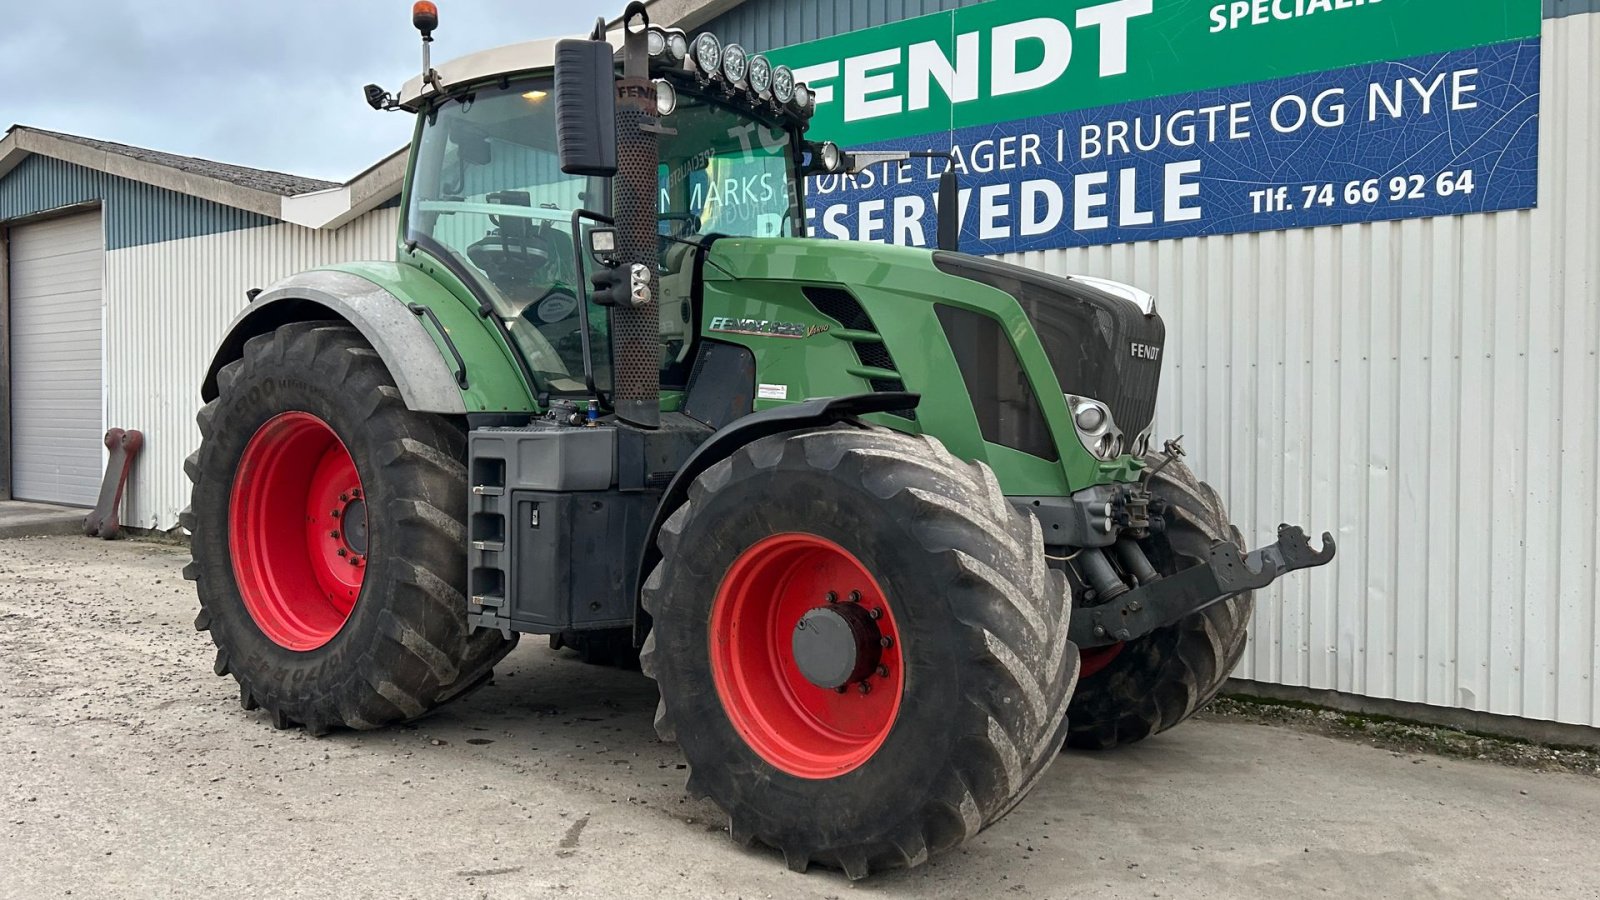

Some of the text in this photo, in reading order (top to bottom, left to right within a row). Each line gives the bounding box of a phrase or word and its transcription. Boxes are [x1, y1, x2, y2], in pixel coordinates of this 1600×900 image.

[791, 0, 1153, 122] FENDT
[926, 134, 1042, 181] LAGER
[1058, 129, 1063, 162] I
[1080, 101, 1251, 159] BRUGTE
[1270, 88, 1346, 134] OG
[1368, 68, 1479, 122] NYE
[1249, 169, 1475, 213] Tlf. 74 66 92 64
[1131, 342, 1159, 360] FENDT
